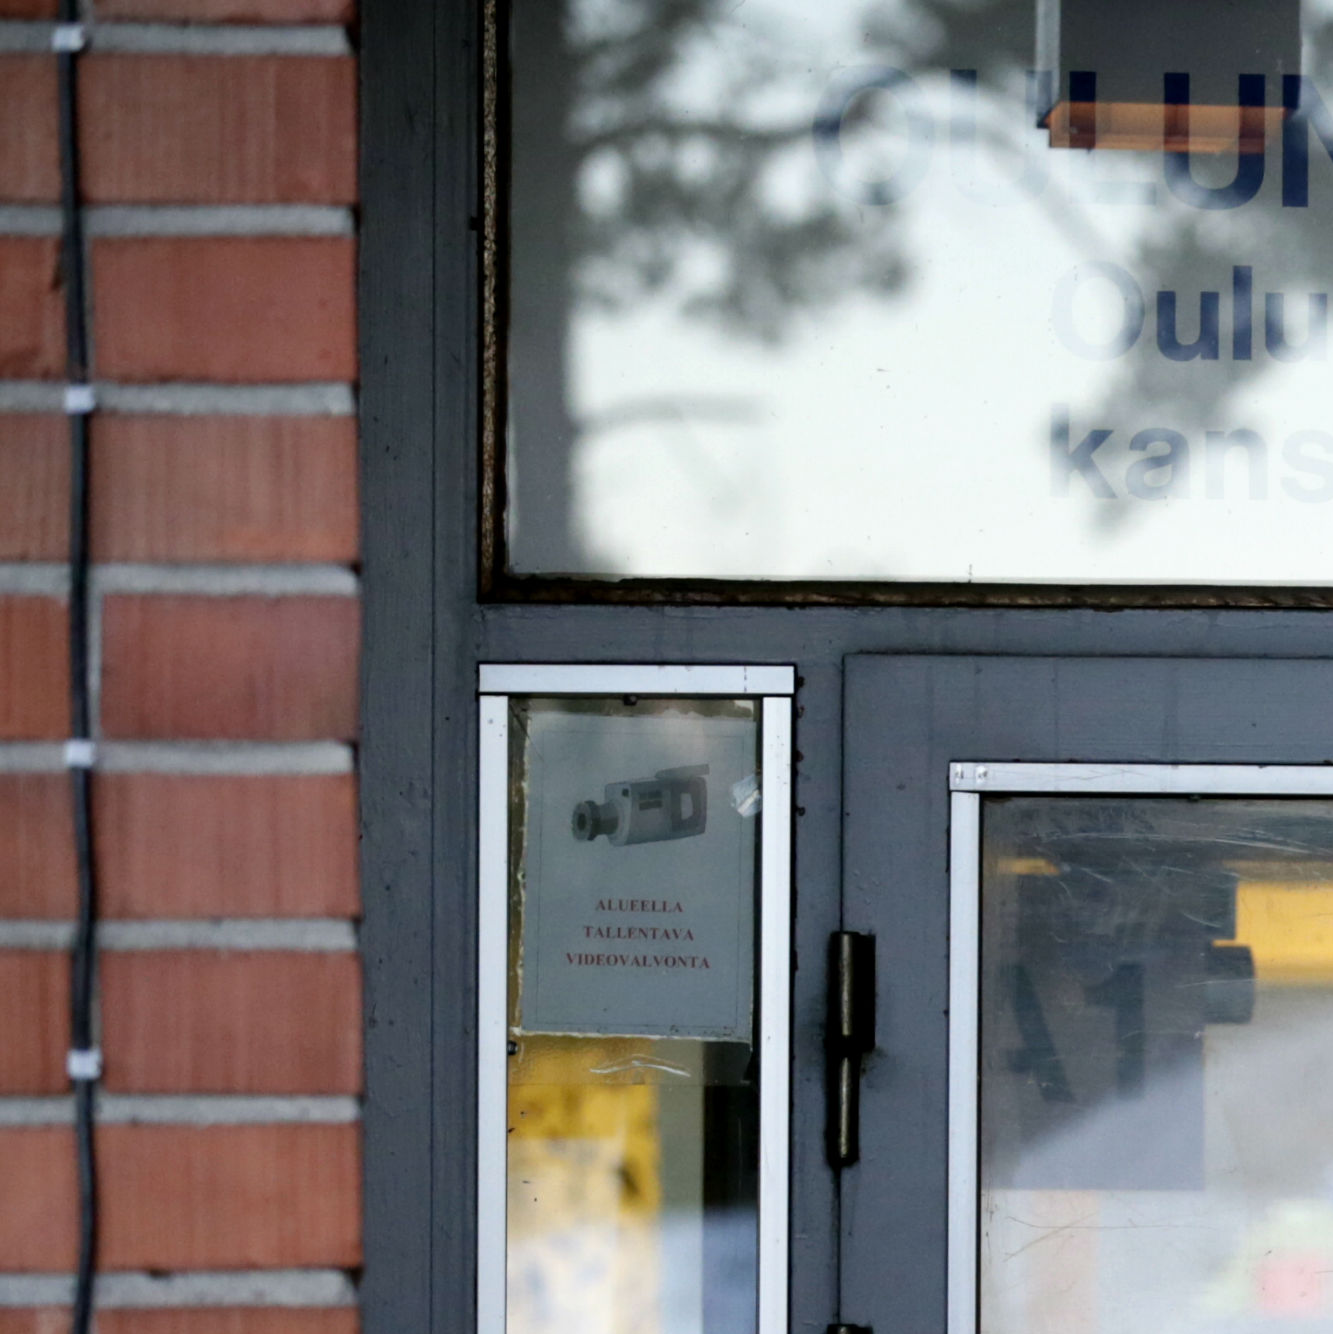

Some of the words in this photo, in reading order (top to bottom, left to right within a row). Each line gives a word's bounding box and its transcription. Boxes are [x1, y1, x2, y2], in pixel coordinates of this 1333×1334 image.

[595, 898, 684, 914] ALUEELLA
[583, 924, 695, 941] TALLENTAVA
[566, 952, 711, 970] VIDEOVALVONTA
